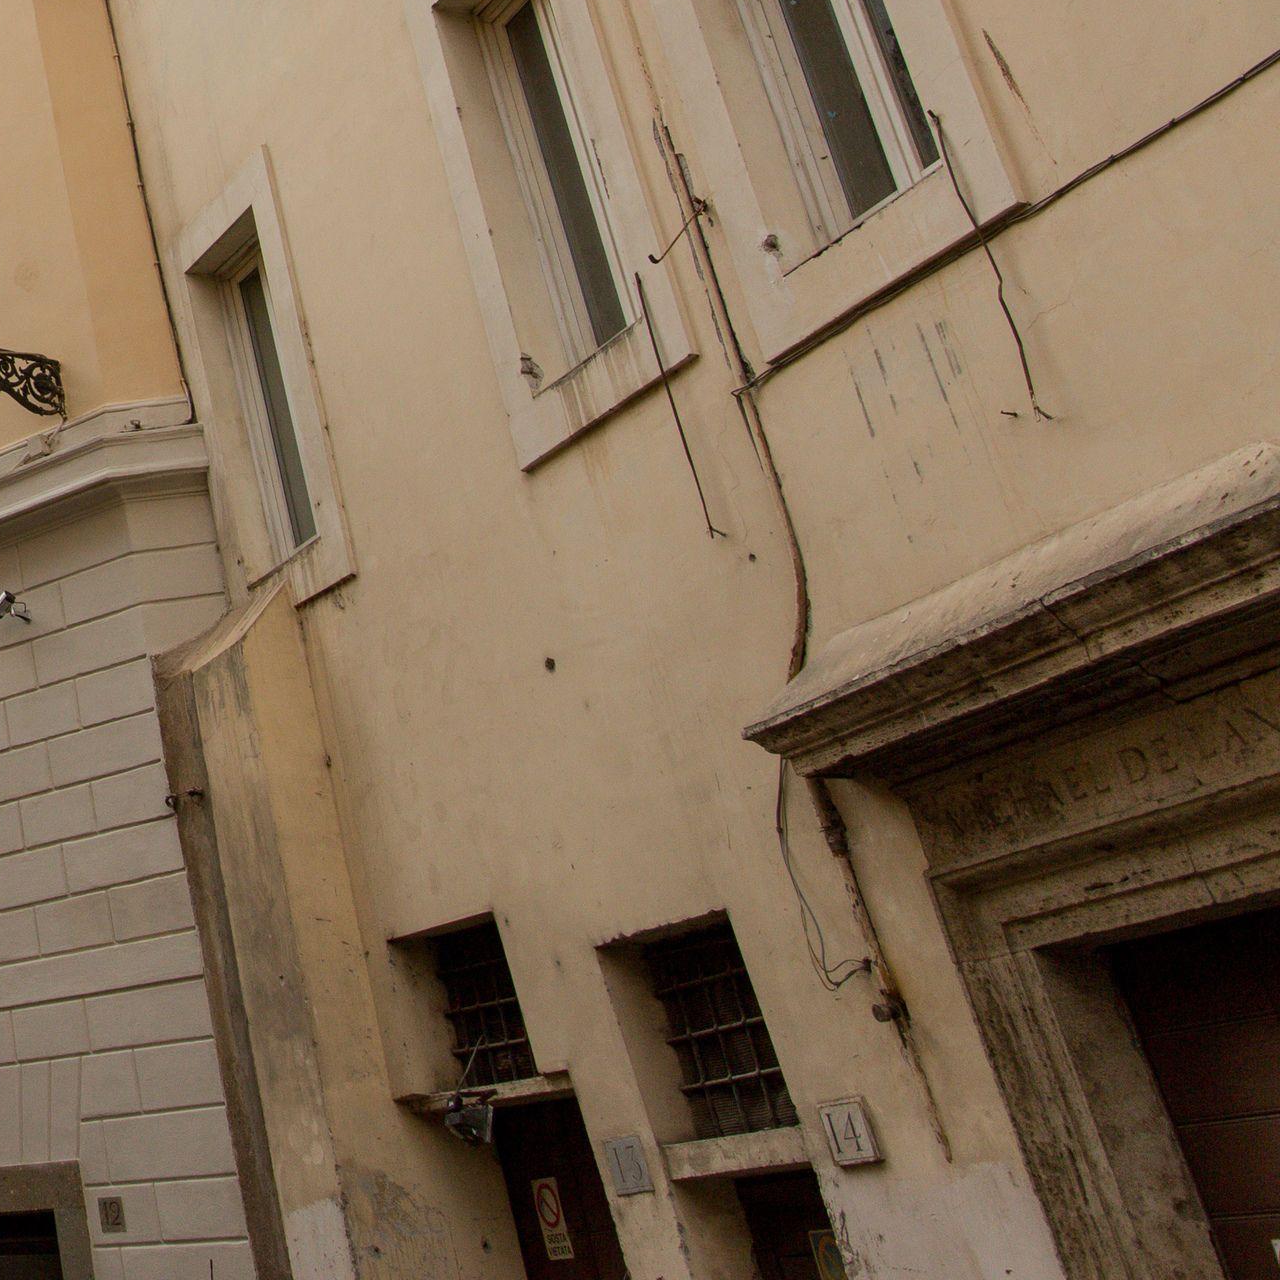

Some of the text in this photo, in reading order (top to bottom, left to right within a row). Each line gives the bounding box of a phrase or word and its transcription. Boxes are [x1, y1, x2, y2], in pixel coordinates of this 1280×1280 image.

[1116, 730, 1179, 787] DE
[825, 1112, 864, 1154] 14
[612, 1145, 645, 1185] 13
[102, 1200, 123, 1227] 12
[546, 1232, 568, 1245] SOSTA
